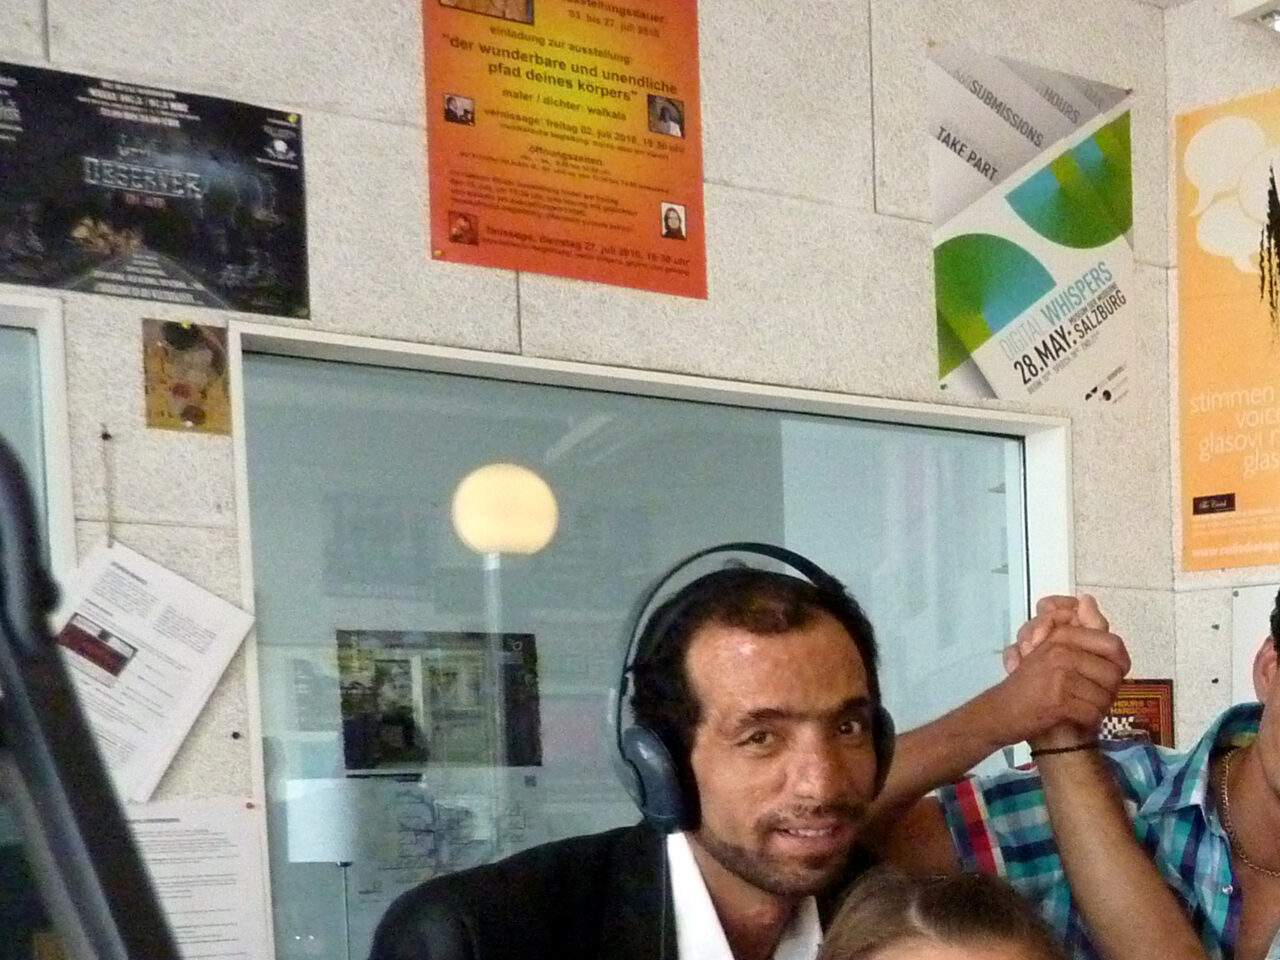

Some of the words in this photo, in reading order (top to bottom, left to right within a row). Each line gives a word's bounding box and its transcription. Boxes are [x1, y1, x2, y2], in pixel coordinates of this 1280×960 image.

[479, 42, 567, 71] wunderbare
[571, 63, 598, 78] und
[602, 69, 678, 95] unendliche
[488, 62, 521, 78] pfad
[526, 68, 573, 89] deines
[969, 80, 1045, 149] SUBMISSIONS
[1042, 87, 1081, 125] HOURS
[936, 126, 968, 158] TAKE
[967, 150, 999, 181] PART
[1040, 261, 1113, 326] WHISPERS
[1073, 289, 1127, 340] SALZBURG
[1189, 387, 1275, 413] stimmen
[1199, 431, 1263, 462] glasovi
